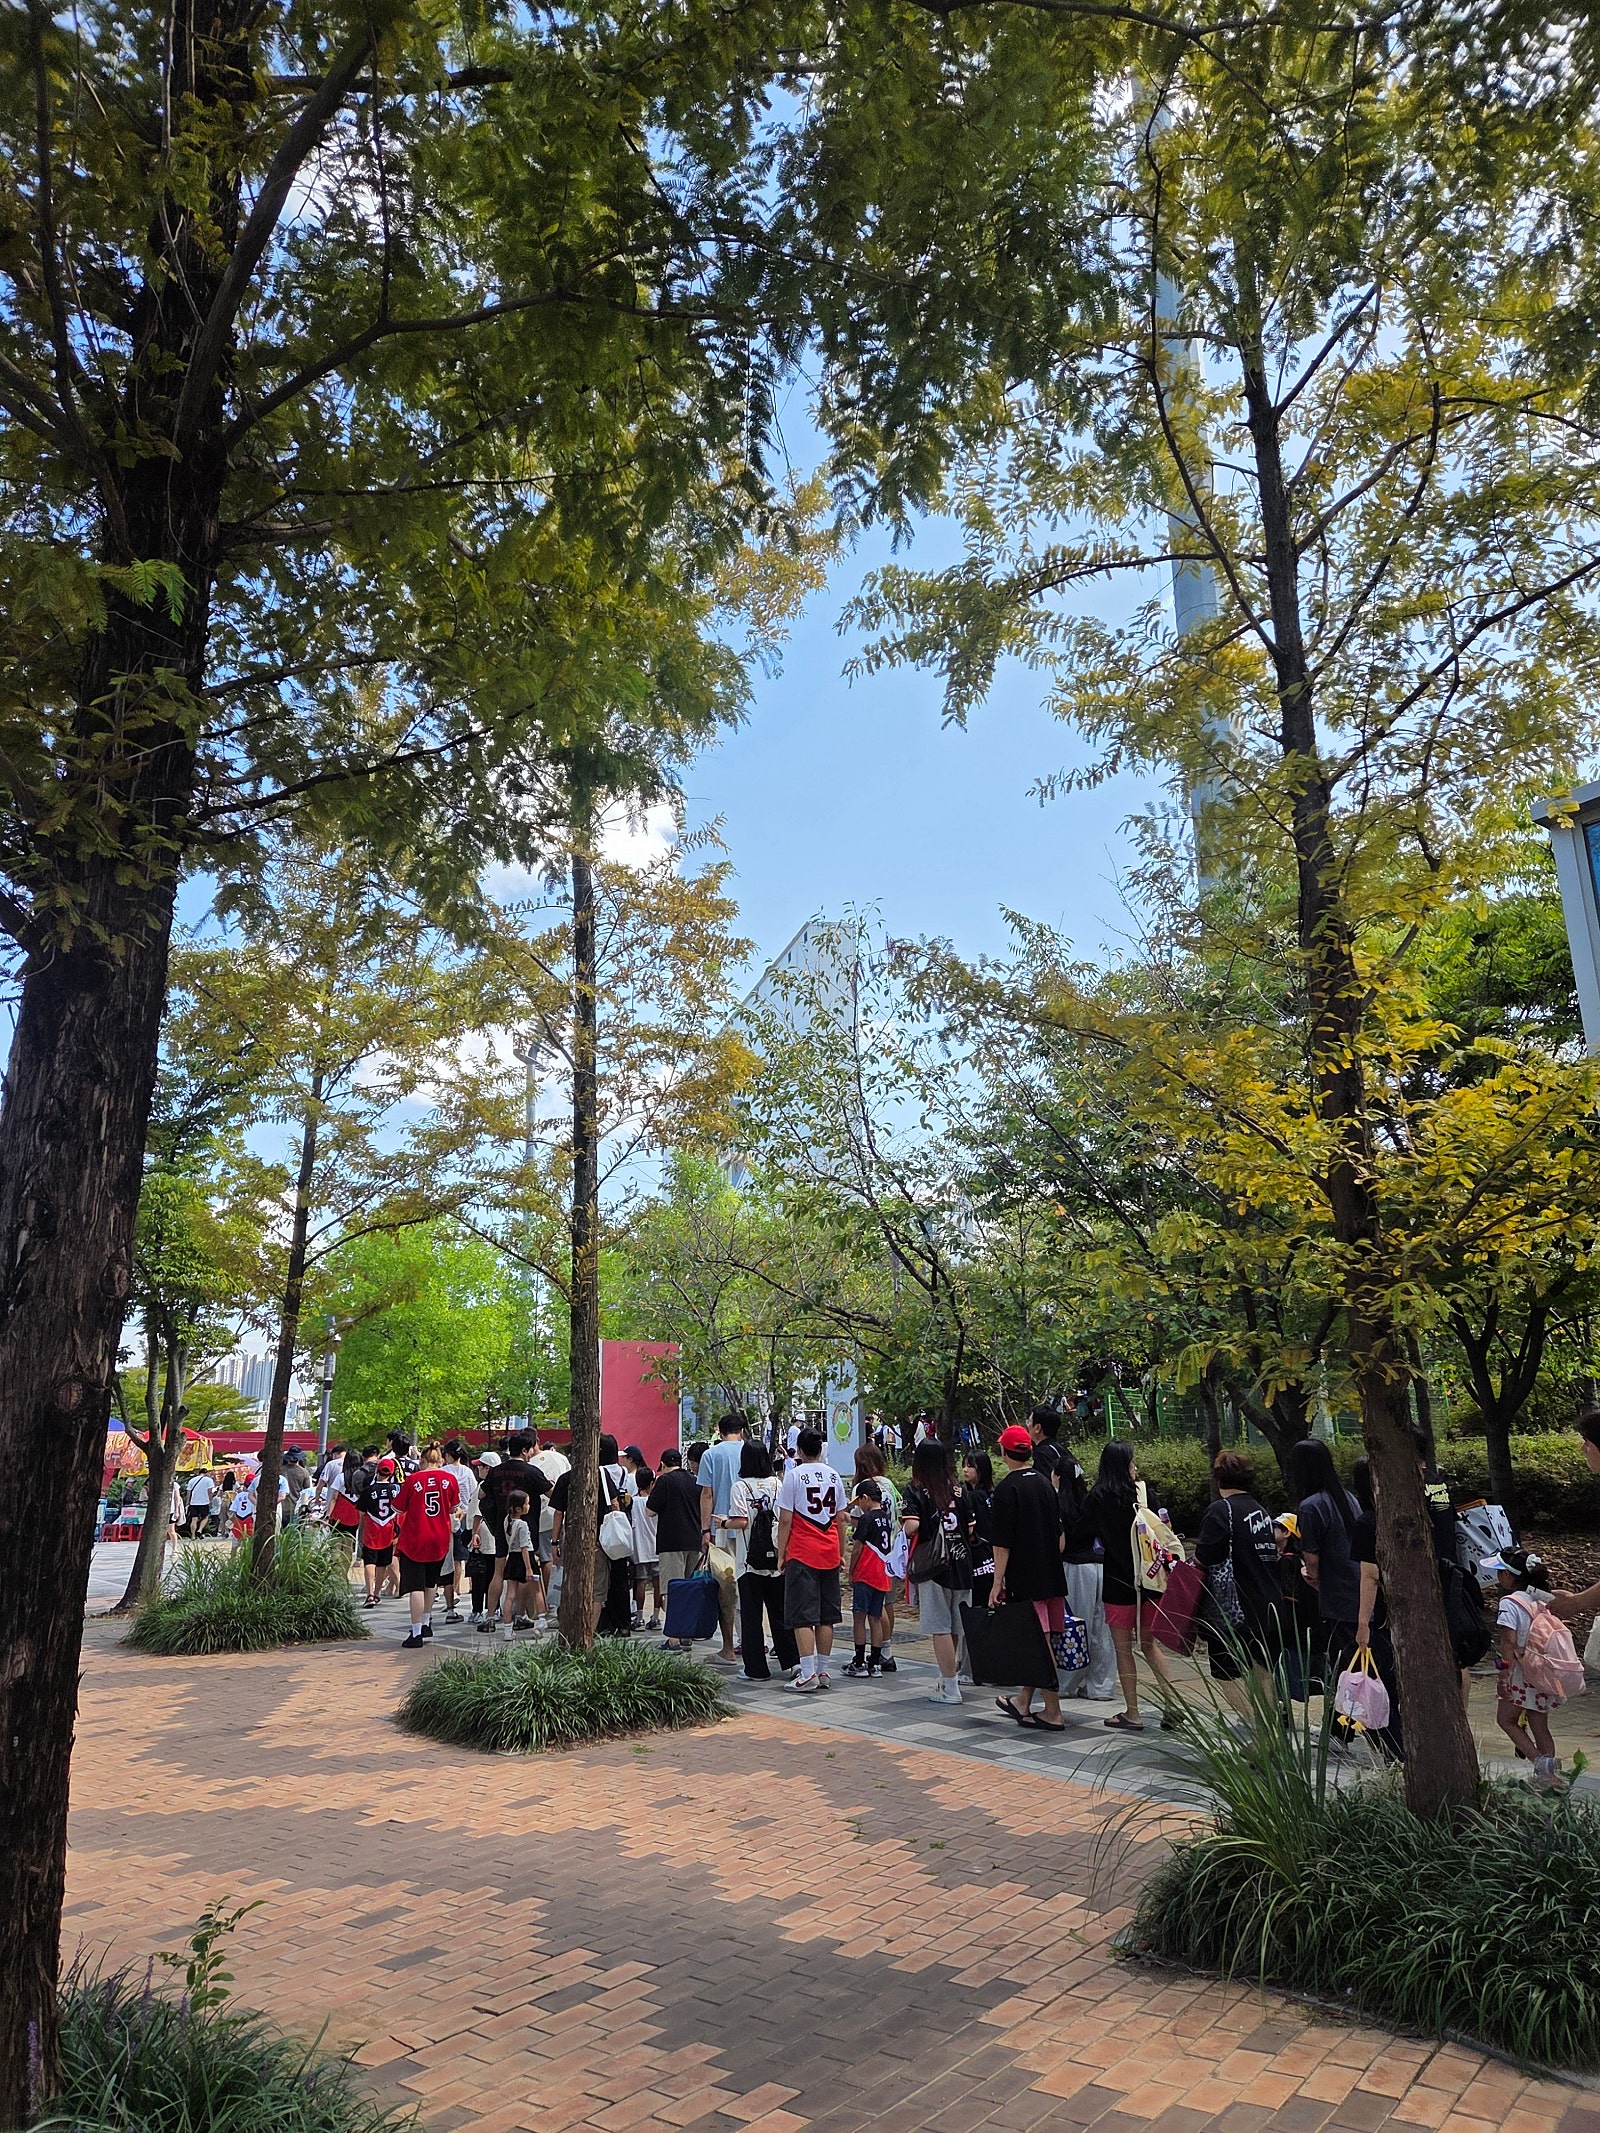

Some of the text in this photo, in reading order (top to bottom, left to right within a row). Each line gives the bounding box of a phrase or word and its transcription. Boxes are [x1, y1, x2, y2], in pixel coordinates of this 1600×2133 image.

[240, 1501, 248, 1511] 5
[378, 1498, 390, 1517] 5
[425, 1491, 440, 1517] 5
[805, 1486, 837, 1515] 54
[881, 1531, 889, 1550] 3
